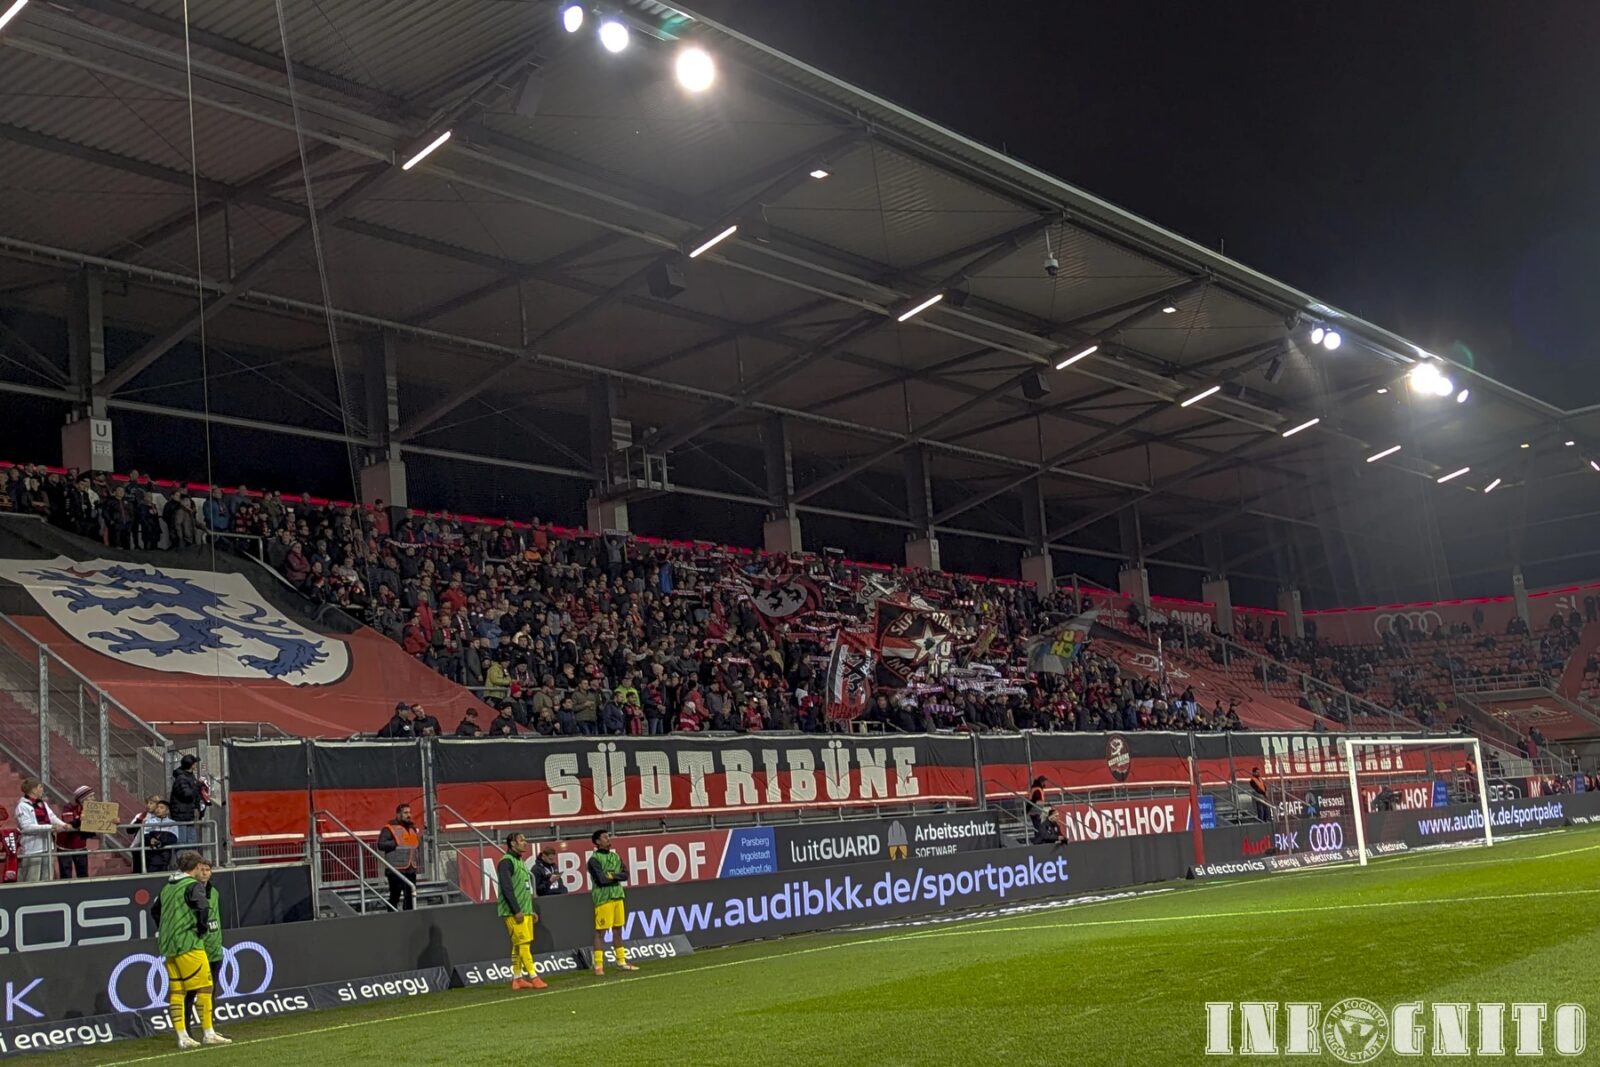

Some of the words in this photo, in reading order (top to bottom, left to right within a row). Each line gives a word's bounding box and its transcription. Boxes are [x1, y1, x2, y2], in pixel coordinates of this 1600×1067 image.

[96, 423, 107, 437] U
[544, 739, 920, 816] SÜDTRIBÜNE
[914, 820, 997, 842] Arbeitsschutz
[740, 850, 771, 862] Ingolstadt
[791, 834, 881, 863] luitGUARD
[1207, 860, 1265, 875] electronics
[623, 942, 677, 959] energy
[466, 966, 484, 984] si
[338, 983, 356, 1001] si
[360, 976, 429, 998] energy
[151, 1009, 174, 1030] si
[14, 1023, 114, 1050] energy
